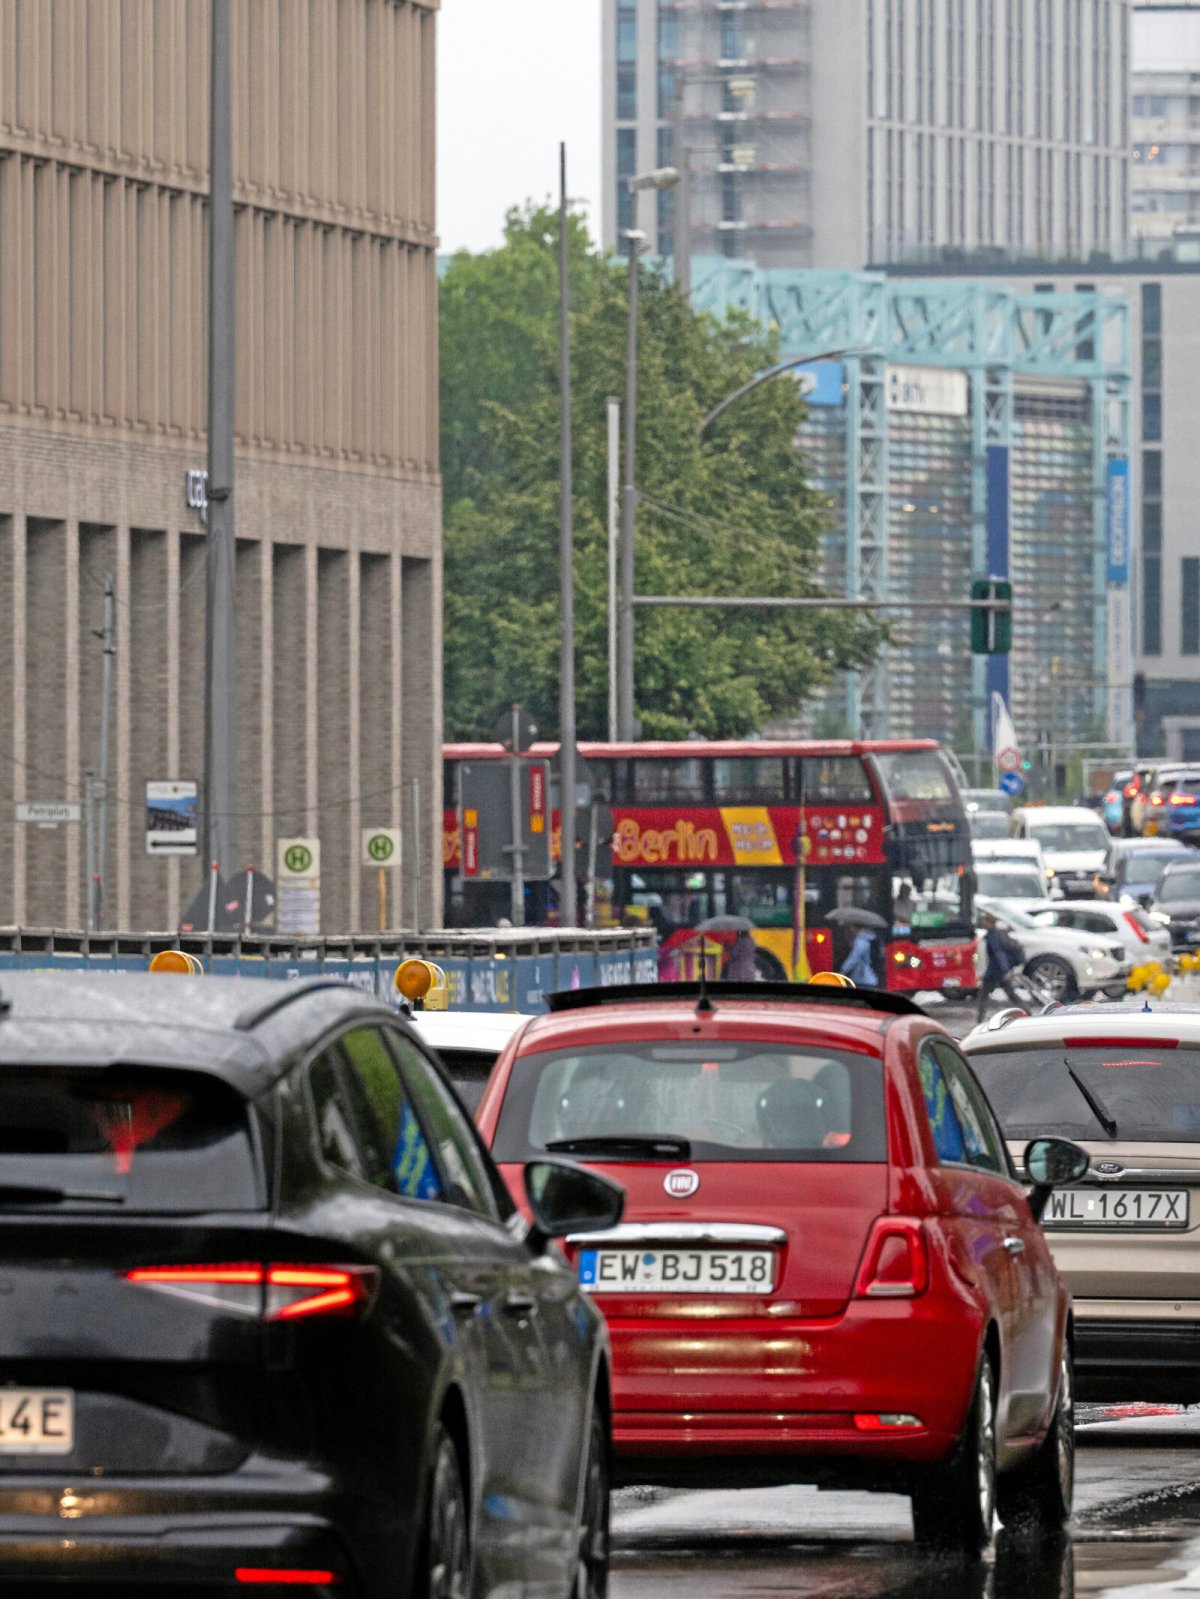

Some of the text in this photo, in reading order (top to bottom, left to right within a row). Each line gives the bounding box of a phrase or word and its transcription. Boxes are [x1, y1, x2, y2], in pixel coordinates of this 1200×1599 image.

[617, 819, 718, 862] Berlin
[1052, 1193, 1180, 1219] WL 1617X
[600, 1255, 766, 1281] EW BJ 518
[0, 1398, 65, 1436] 4E
